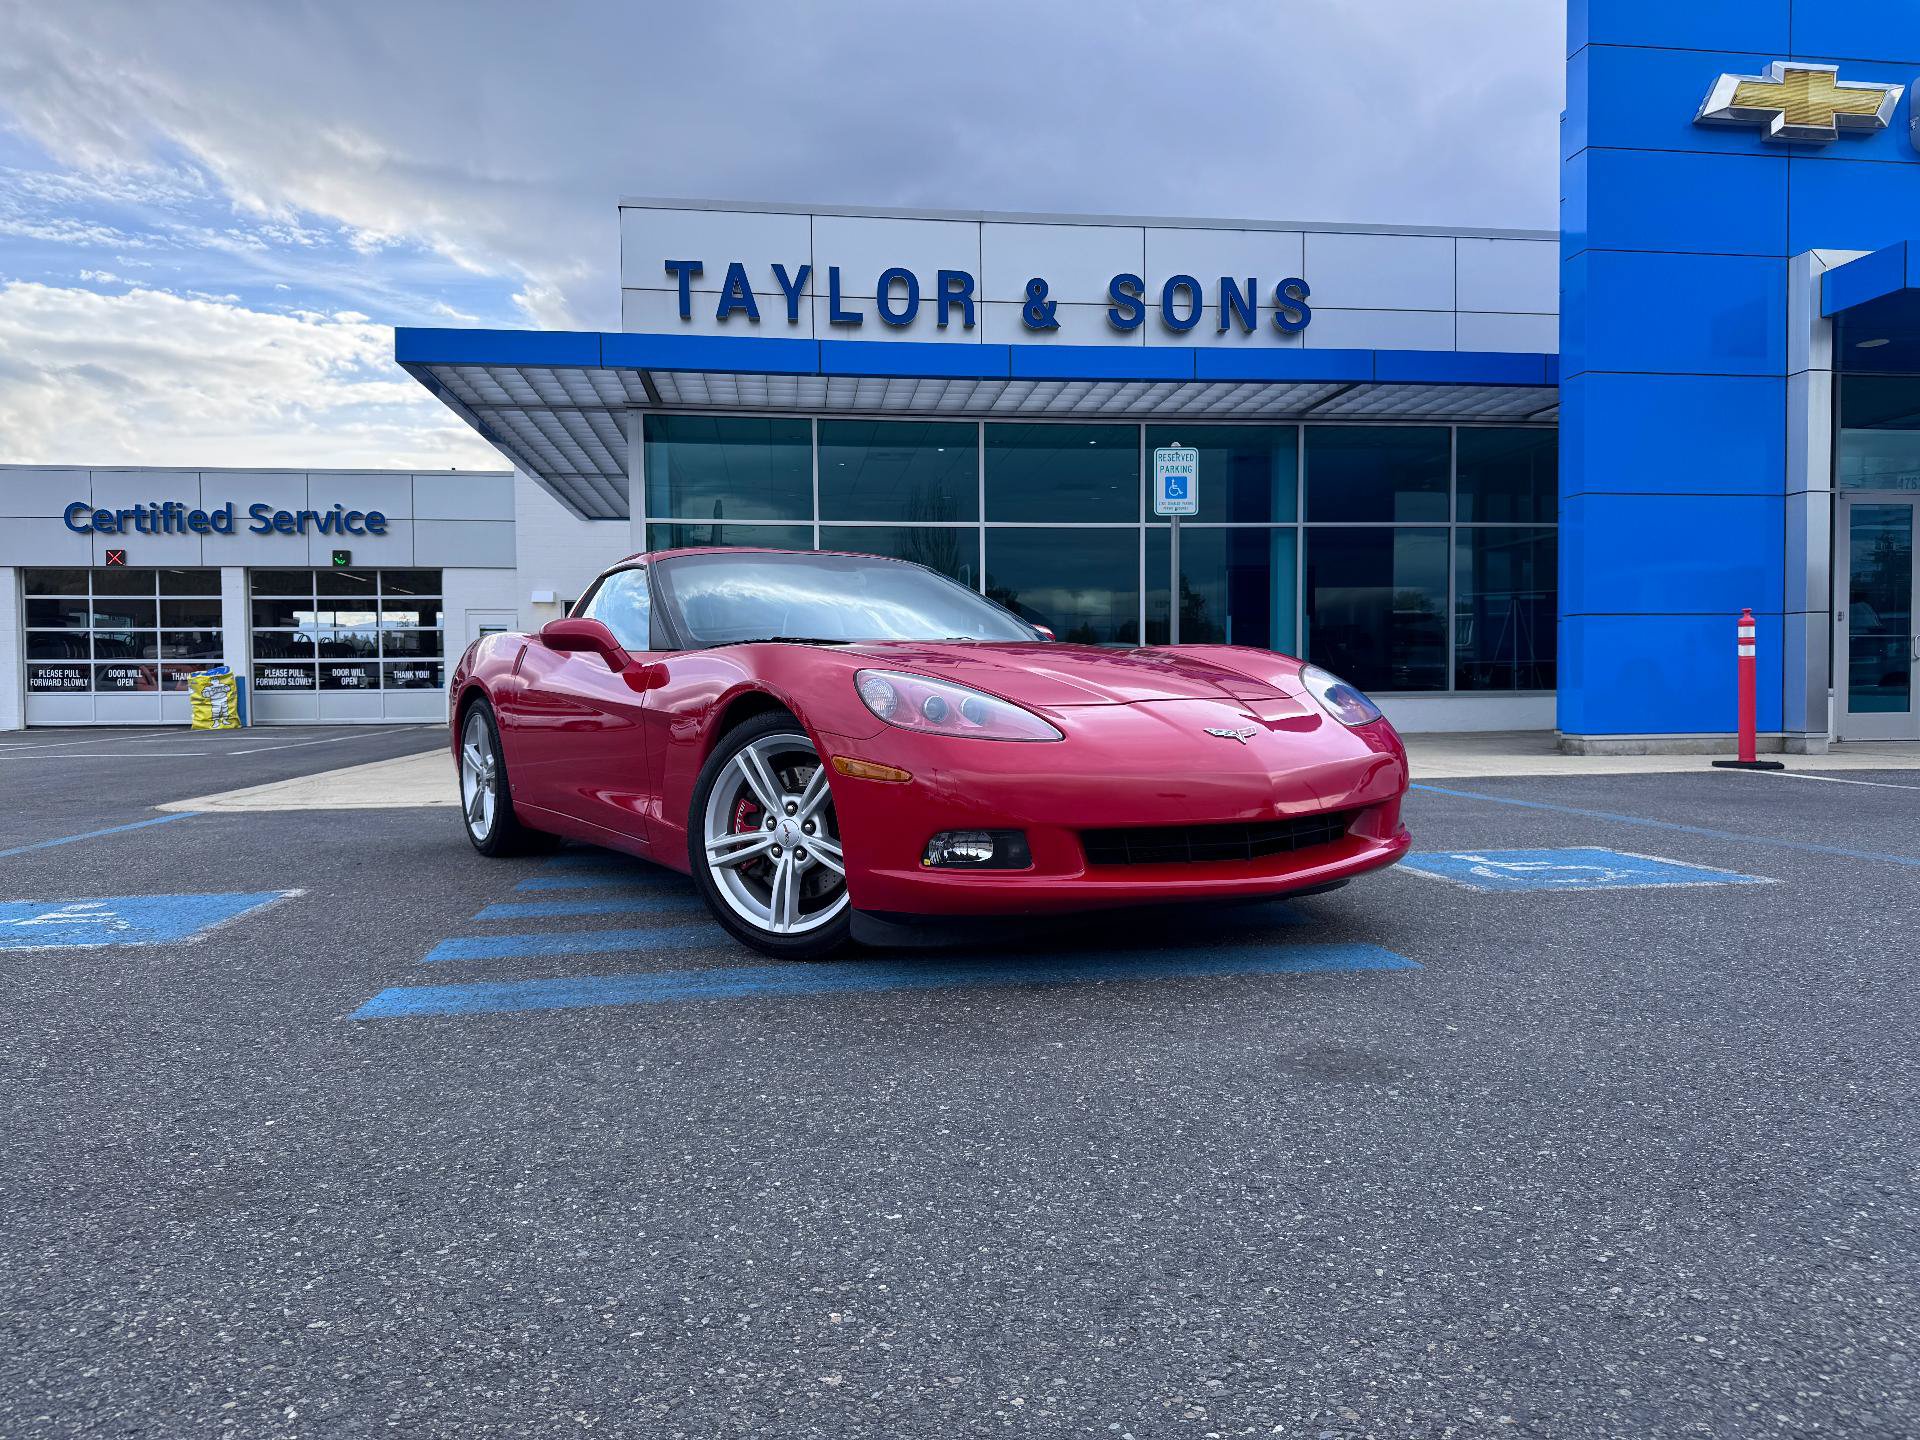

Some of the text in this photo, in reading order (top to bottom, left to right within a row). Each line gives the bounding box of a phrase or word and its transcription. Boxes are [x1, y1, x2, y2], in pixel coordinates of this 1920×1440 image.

[664, 259, 1312, 333] TAYLOR & SONS
[1158, 454, 1194, 462] RESERVED
[1160, 465, 1193, 474] PARKING
[63, 501, 387, 534] Certified Service
[38, 669, 80, 678] PLEASE PULL
[108, 669, 142, 678] DOOR WILL
[264, 669, 305, 677] PLEASE PULL
[332, 668, 366, 677] DOOR WILL
[393, 670, 430, 679] THANK YOU!
[30, 678, 89, 687] FORWARD SLOWLY
[116, 678, 134, 687] OPEN
[255, 677, 313, 686] FORWARD SLOWLY
[341, 677, 358, 686] OPEN
